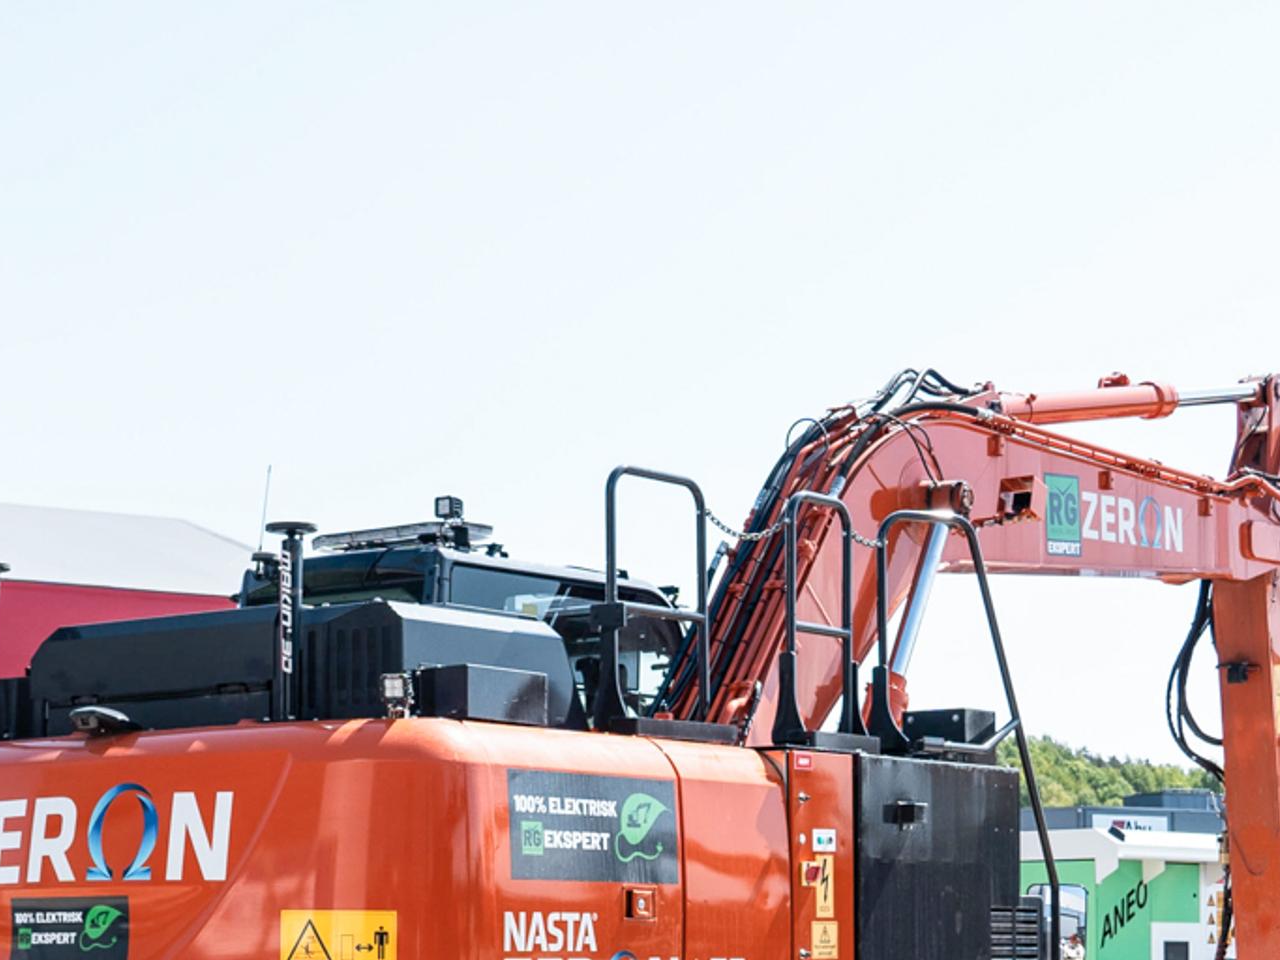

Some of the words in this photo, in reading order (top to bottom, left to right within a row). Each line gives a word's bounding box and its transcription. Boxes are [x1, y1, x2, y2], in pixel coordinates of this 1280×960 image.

[513, 794, 548, 815] 100%
[548, 796, 617, 819] ELEKTRISK
[544, 827, 610, 852] EKSPERT
[14, 911, 35, 924] 100%
[35, 911, 83, 924] ELEKTRISK
[1099, 881, 1149, 949] ANEO
[31, 932, 77, 944] EKSPERT
[503, 911, 598, 953] NASTA
